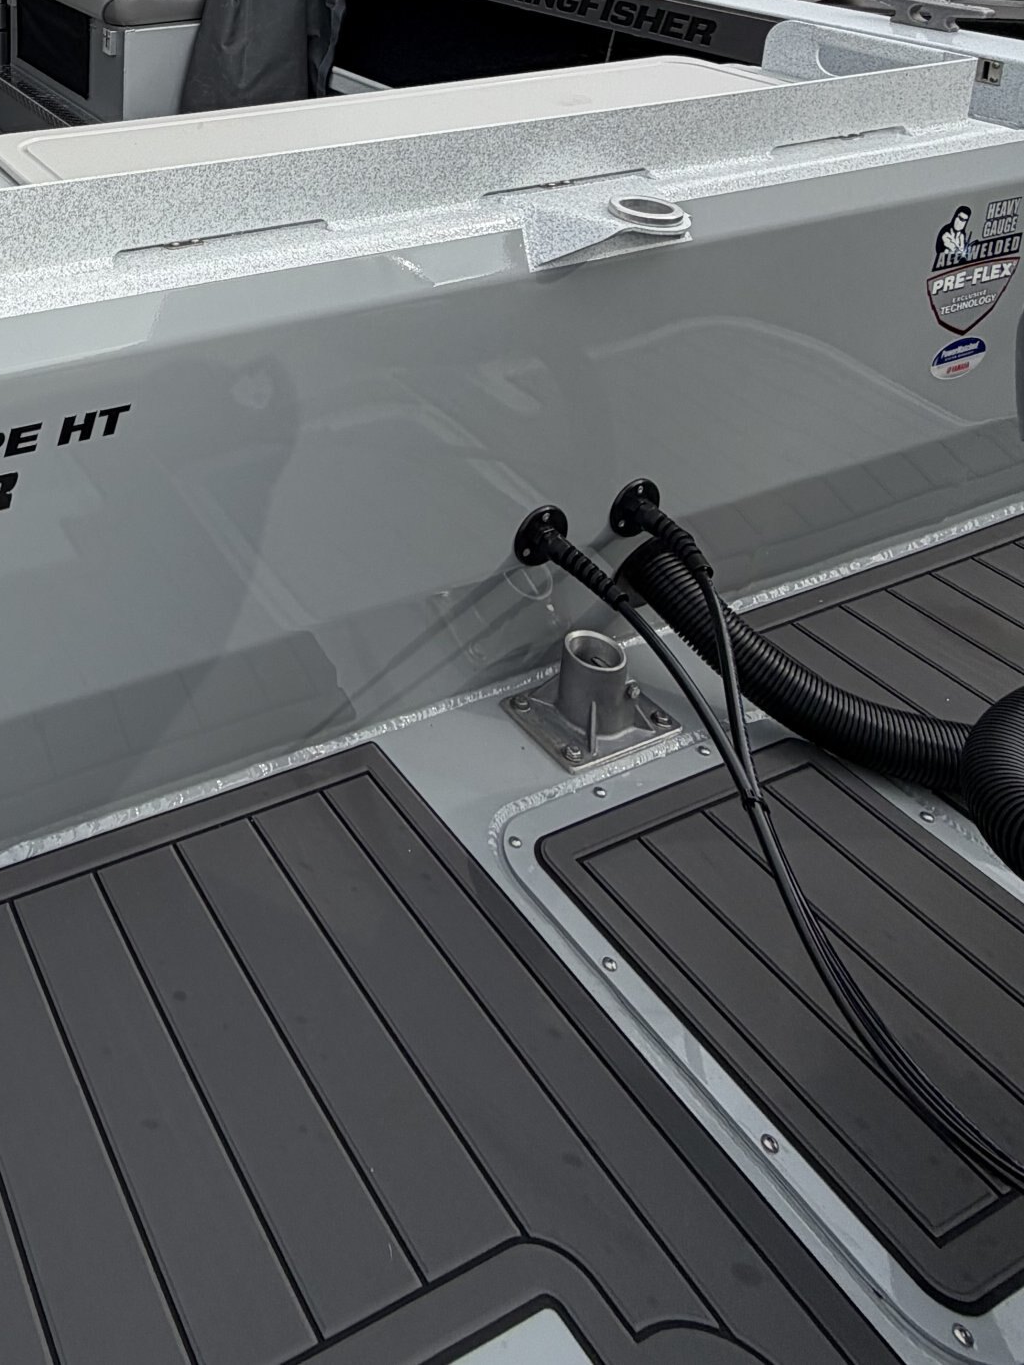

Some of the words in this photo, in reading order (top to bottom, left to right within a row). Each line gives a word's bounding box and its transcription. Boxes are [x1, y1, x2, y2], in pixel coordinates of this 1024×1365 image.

[986, 198, 1021, 220] HEAVY
[983, 216, 1018, 238] GAUGE
[967, 236, 1021, 261] WELDED
[932, 262, 1012, 295] PRE-FLEX
[940, 293, 997, 315] TECHNOLOGY
[951, 289, 987, 303] EXCLUSIVE
[56, 404, 132, 446] HT
